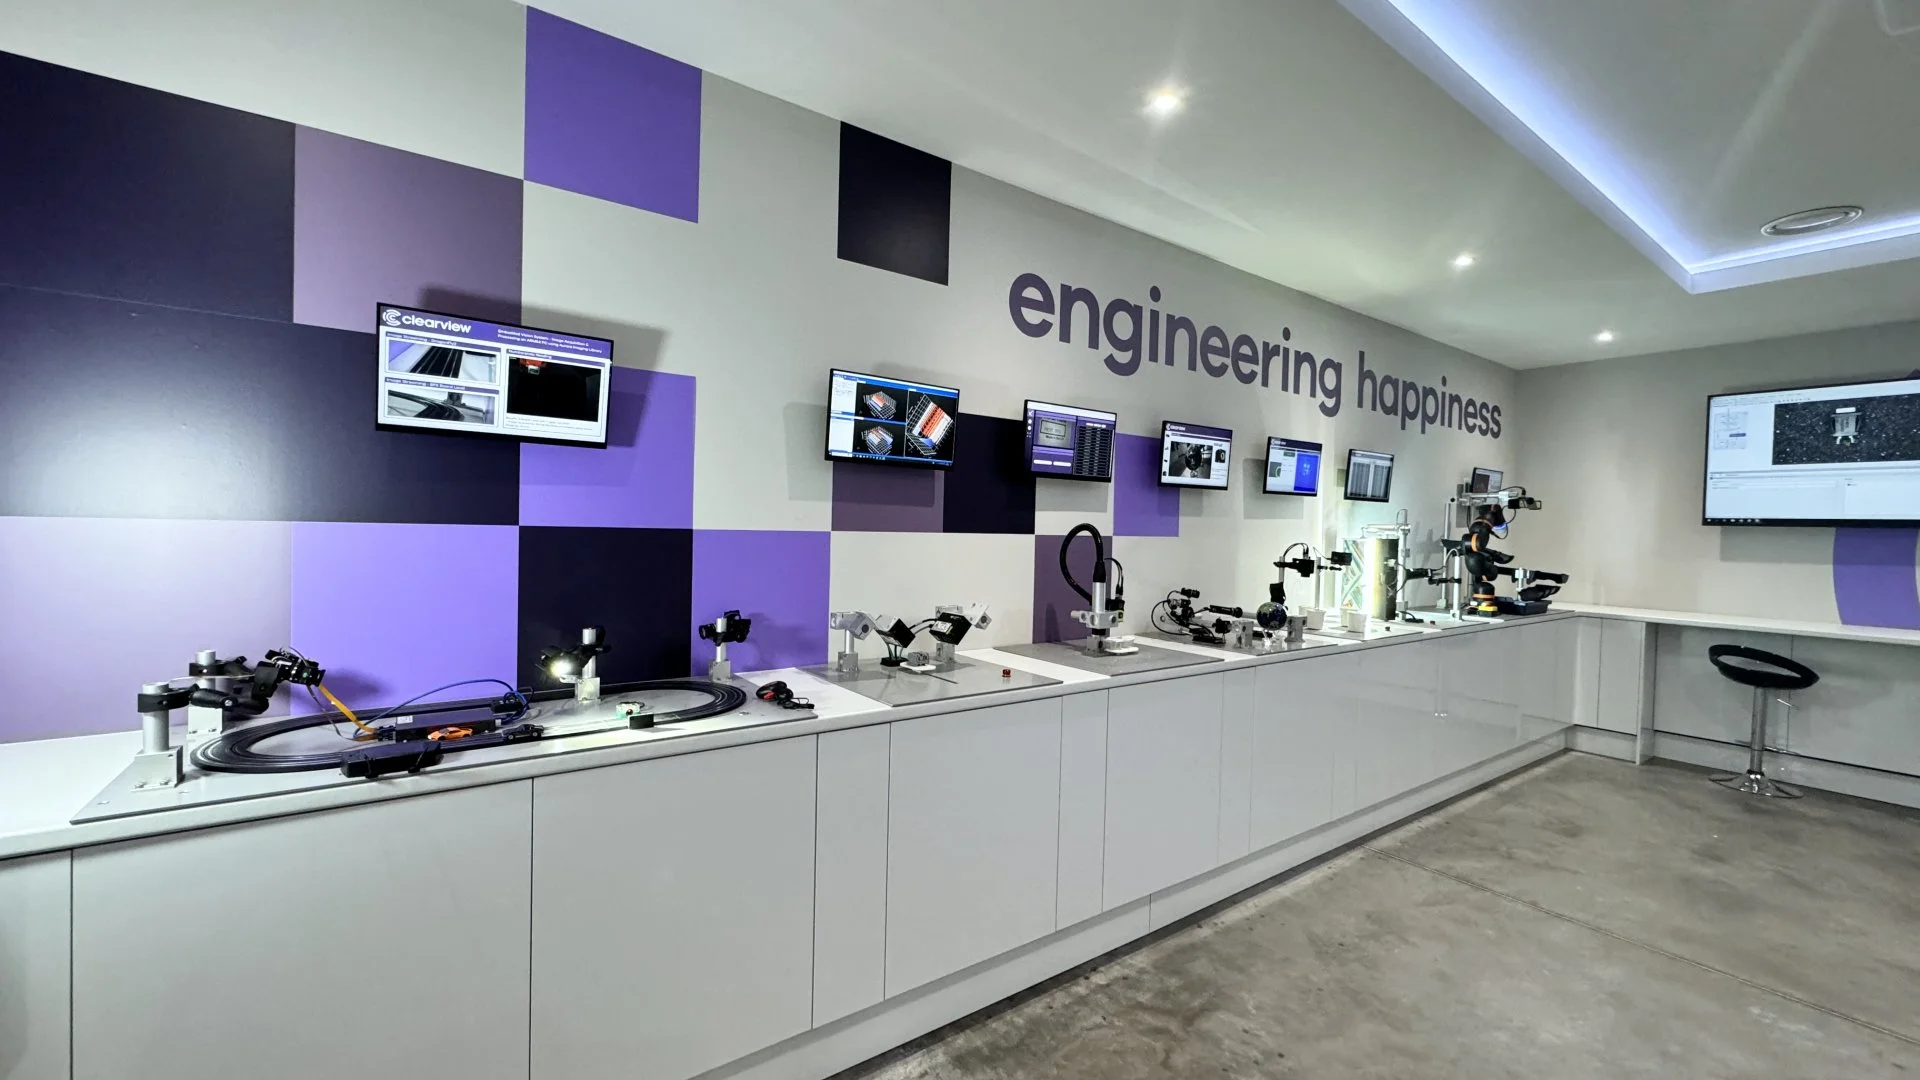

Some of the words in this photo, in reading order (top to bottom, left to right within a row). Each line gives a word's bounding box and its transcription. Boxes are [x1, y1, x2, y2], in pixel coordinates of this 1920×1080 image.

[401, 314, 472, 333] clearview
[1009, 273, 1342, 417] engineering
[1357, 350, 1501, 439] happiness
